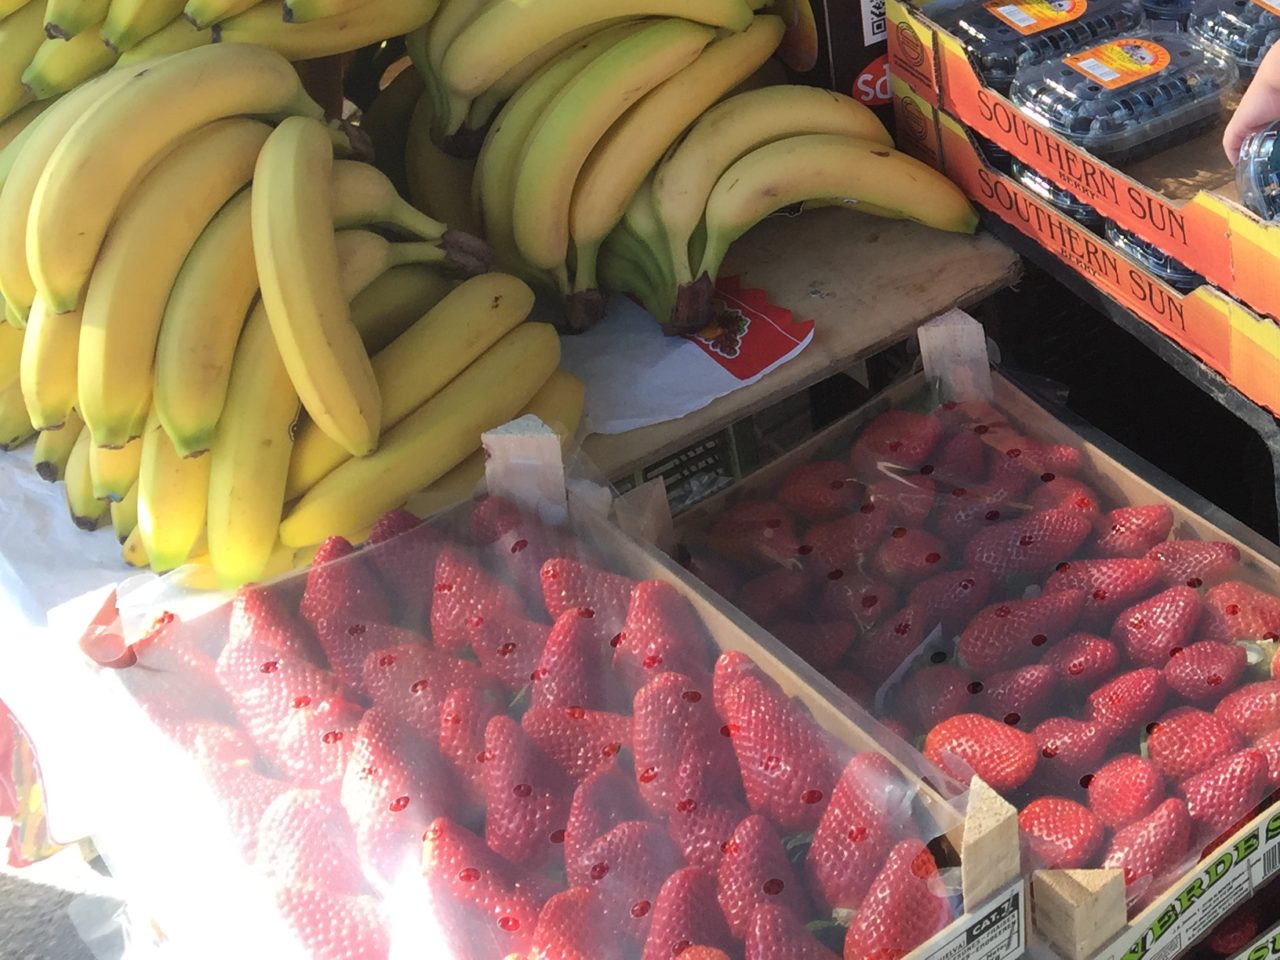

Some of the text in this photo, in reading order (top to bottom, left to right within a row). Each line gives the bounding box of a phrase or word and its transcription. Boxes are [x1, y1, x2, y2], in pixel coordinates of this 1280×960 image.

[977, 89, 1188, 246] SOUTHERN SUN
[1058, 170, 1097, 200] BERRY
[977, 168, 1186, 331] SOUTHERN SUN
[971, 909, 999, 937] CAT.
[1118, 826, 1261, 960] VERDE
